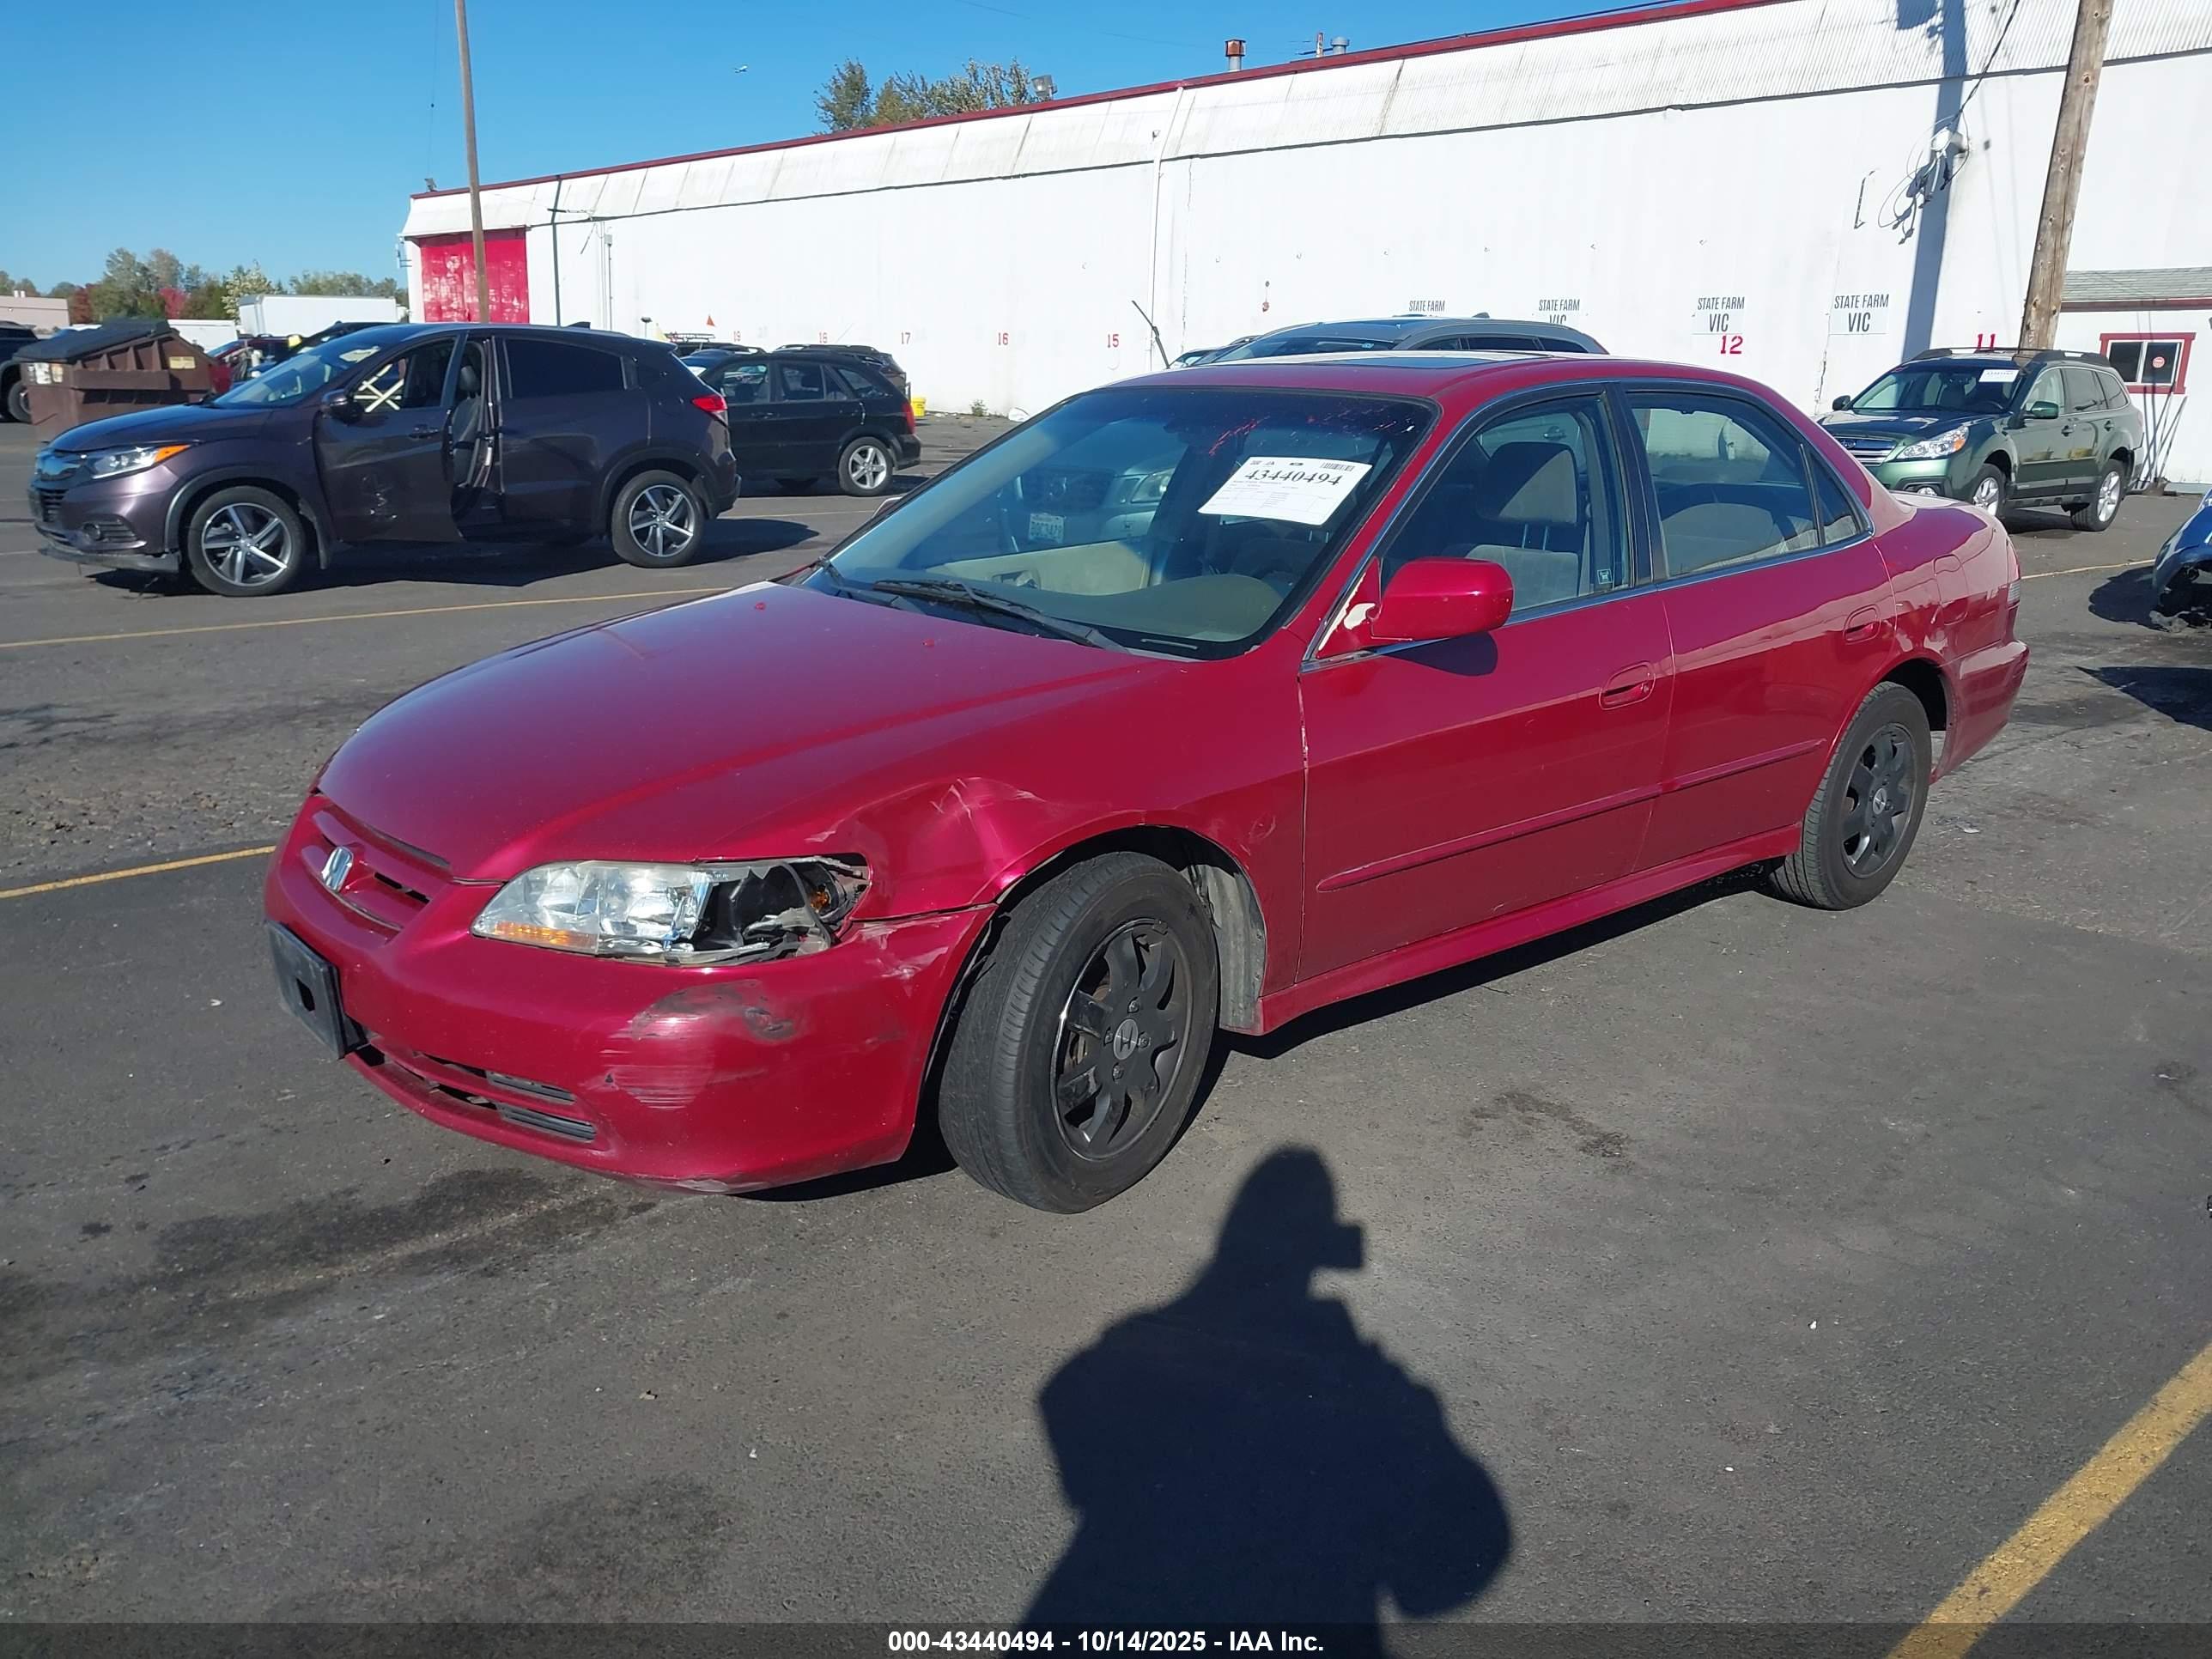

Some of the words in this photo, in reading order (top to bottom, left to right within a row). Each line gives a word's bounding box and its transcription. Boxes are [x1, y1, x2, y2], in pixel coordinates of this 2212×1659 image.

[1409, 301, 1425, 312] STATE
[1427, 301, 1445, 312] FARM
[1539, 300, 1558, 311] STATE
[1559, 299, 1580, 311] FARM
[1698, 297, 1719, 310] STATE
[1722, 297, 1745, 309] FARM
[1834, 295, 1860, 309] STATE
[1862, 295, 1889, 307] FARM
[1709, 313, 1729, 332] VIC
[1848, 313, 1870, 332] VIC
[901, 332, 911, 344] 17
[998, 332, 1009, 345] 16
[1107, 333, 1120, 348] 15
[1720, 335, 1744, 354] 12
[1245, 470, 1343, 486] 43440494
